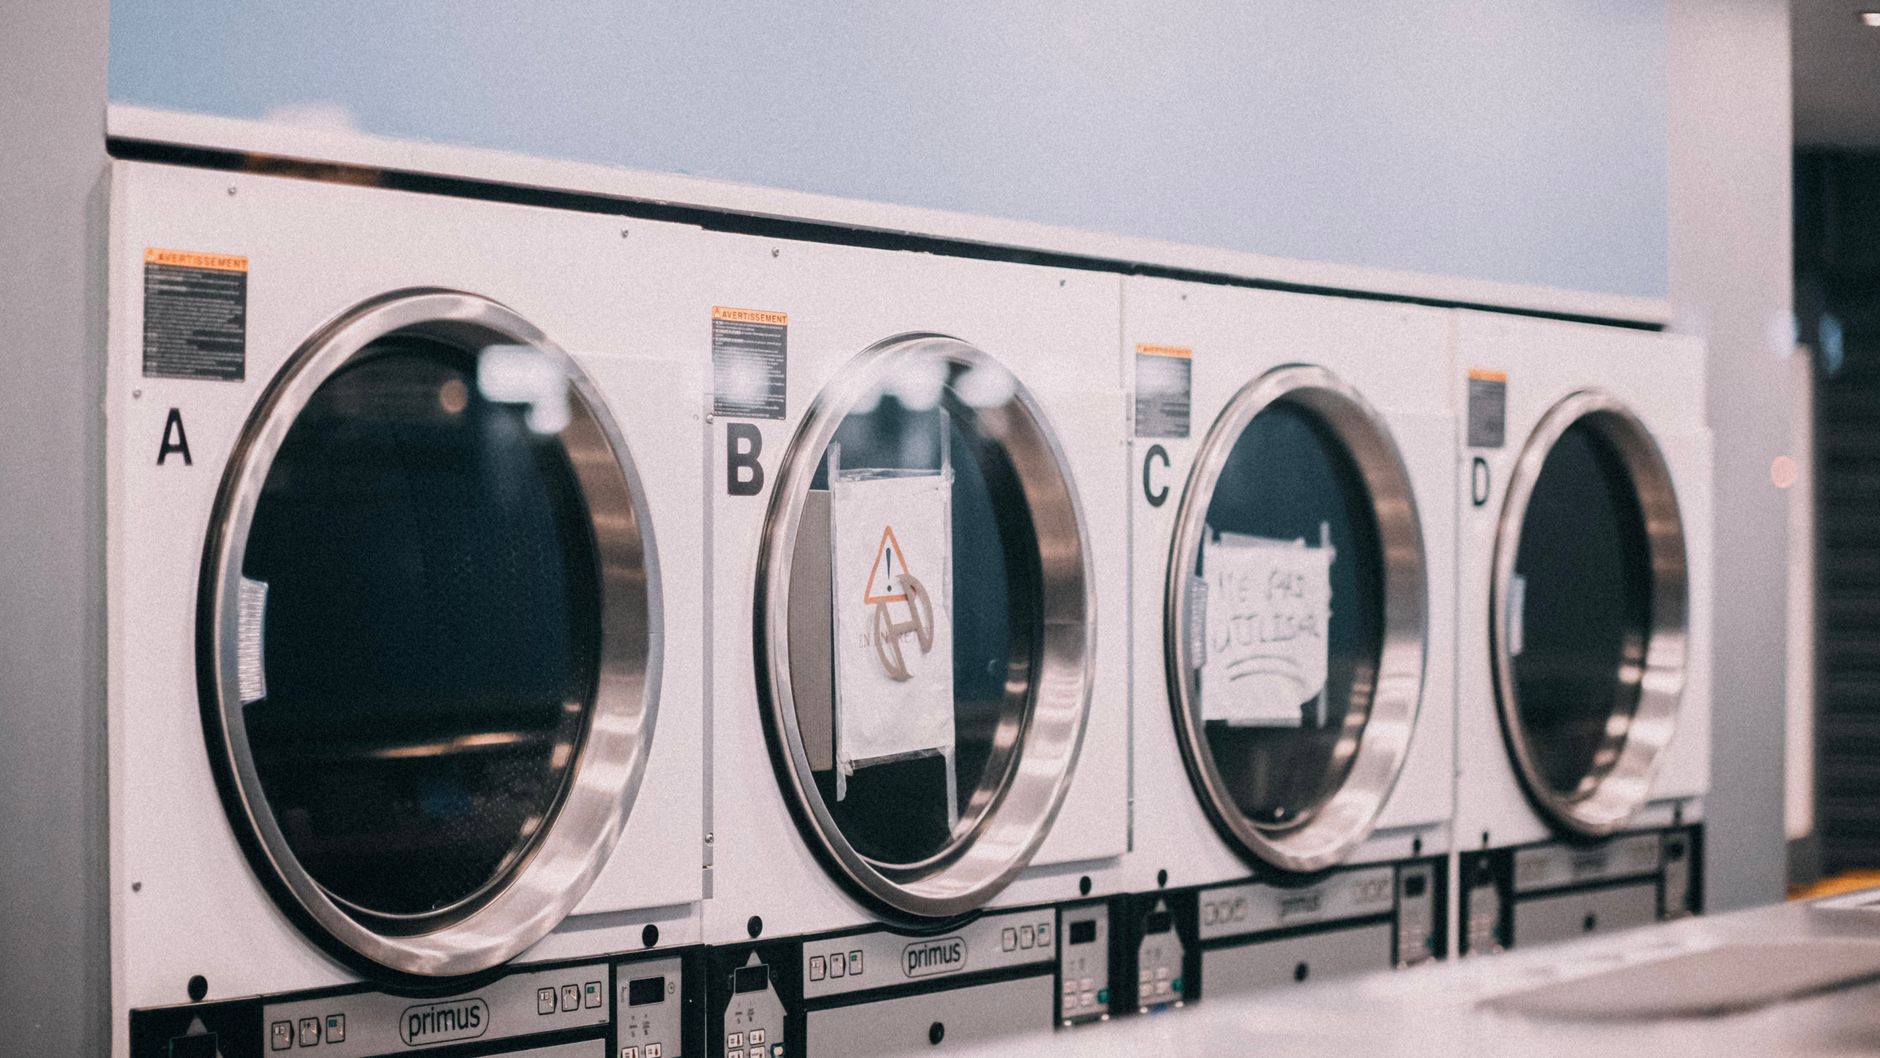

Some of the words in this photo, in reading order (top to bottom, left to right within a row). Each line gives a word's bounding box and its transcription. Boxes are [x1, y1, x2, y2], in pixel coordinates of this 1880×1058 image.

[722, 311, 787, 324] AVERTISSEMENT
[157, 408, 192, 465] A
[727, 423, 764, 496] B
[1143, 444, 1170, 507] C
[1472, 456, 1490, 506] D
[908, 943, 960, 975] primus
[409, 1005, 481, 1042] primus
